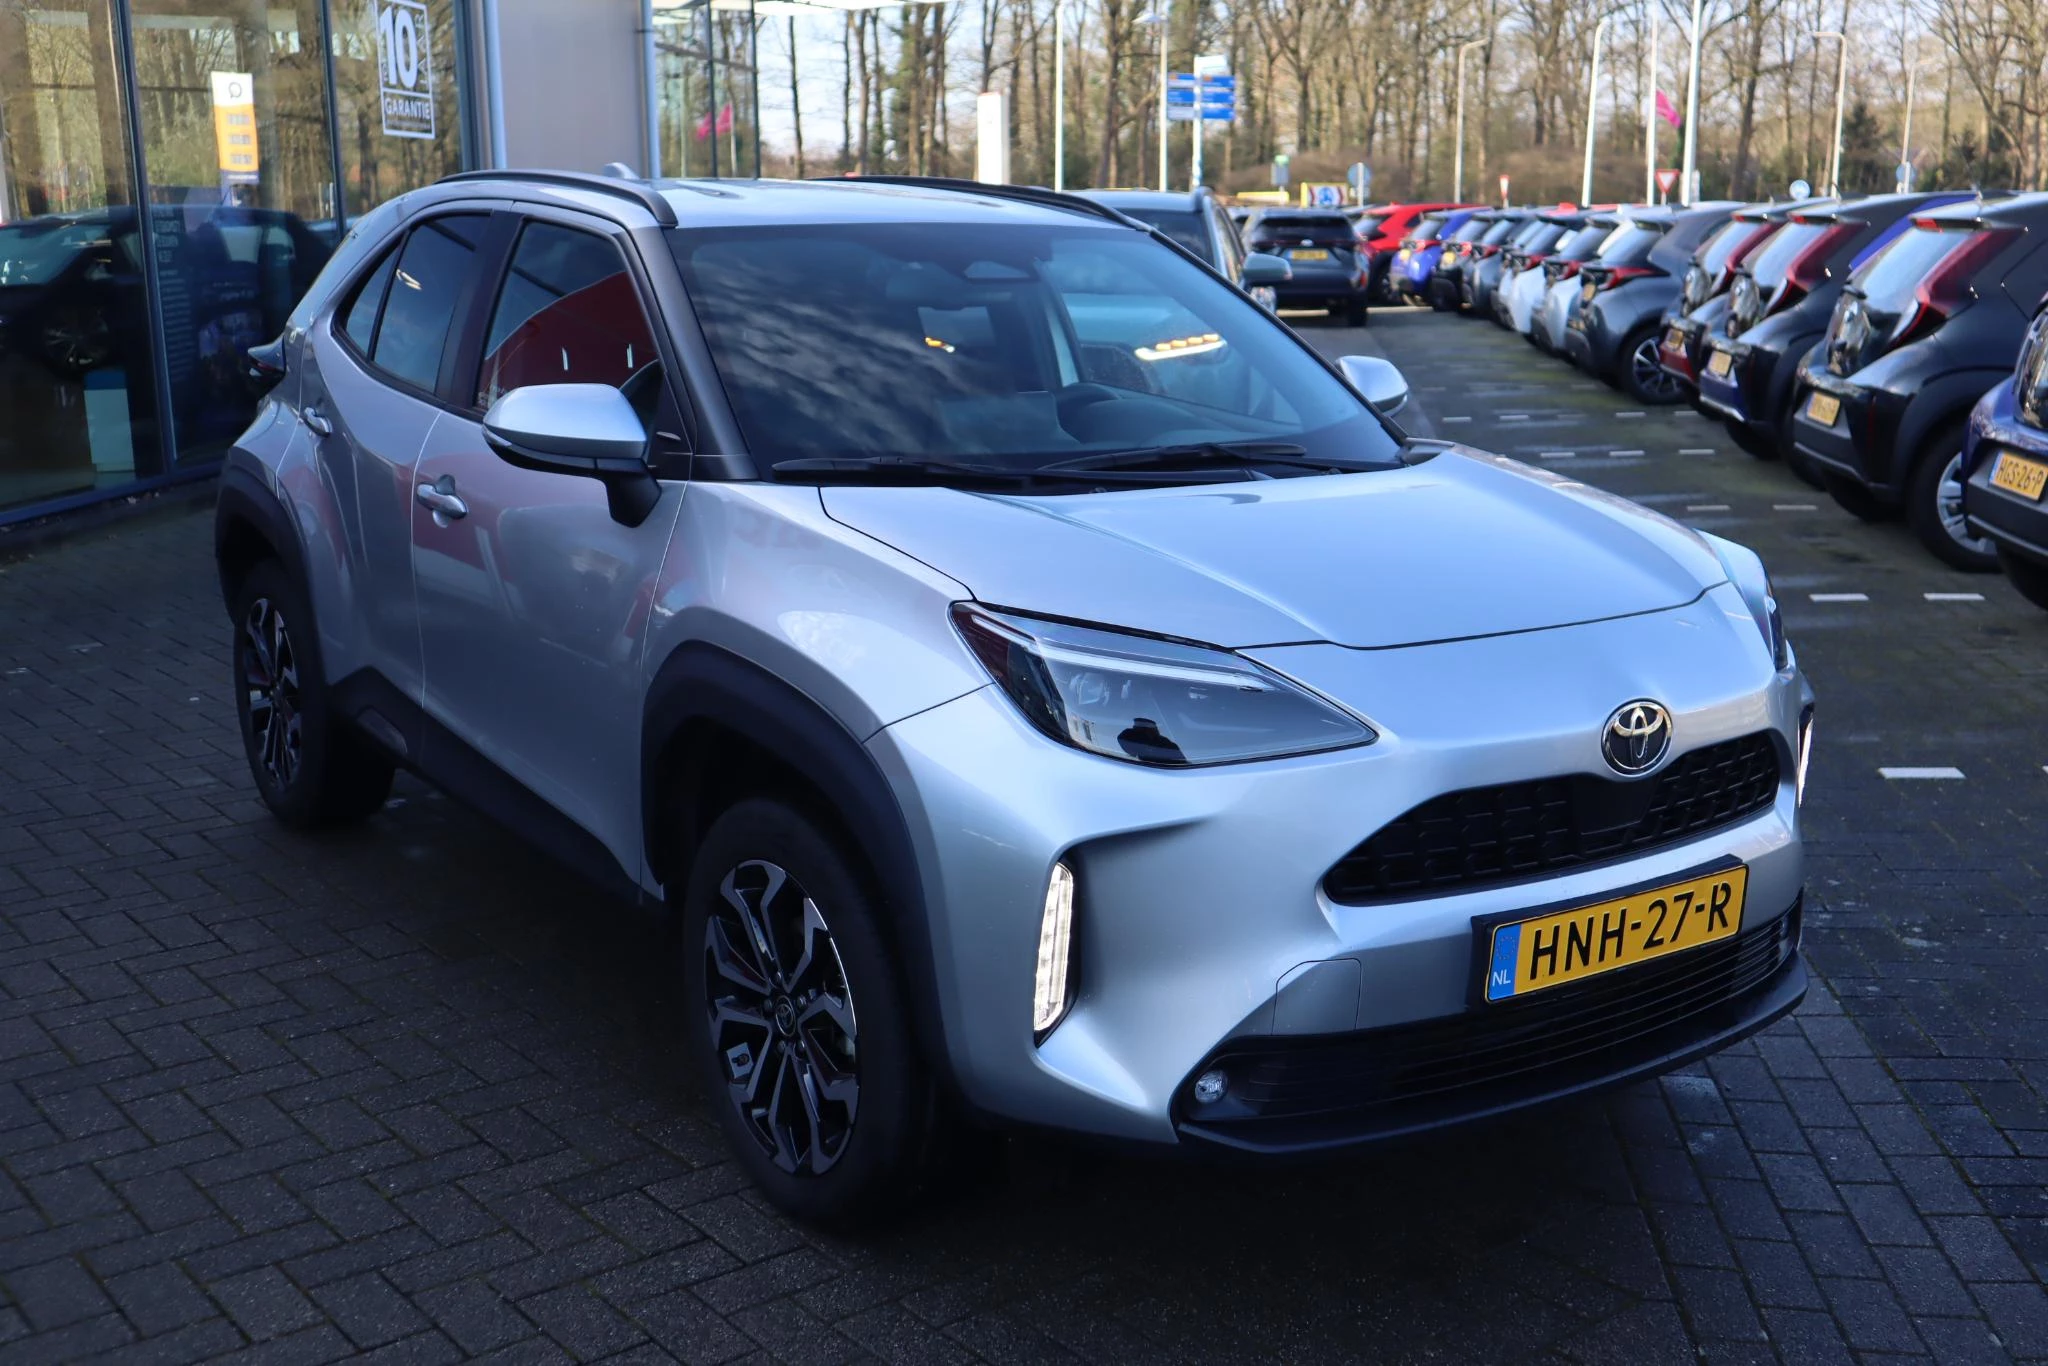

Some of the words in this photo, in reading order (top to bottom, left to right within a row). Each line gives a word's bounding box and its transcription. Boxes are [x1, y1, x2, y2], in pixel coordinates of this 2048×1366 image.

[380, 6, 418, 88] 10
[414, 13, 428, 86] JAAR
[384, 97, 431, 119] GARANTIE
[1530, 881, 1732, 981] HNH-27-R
[1492, 969, 1511, 987] NL
